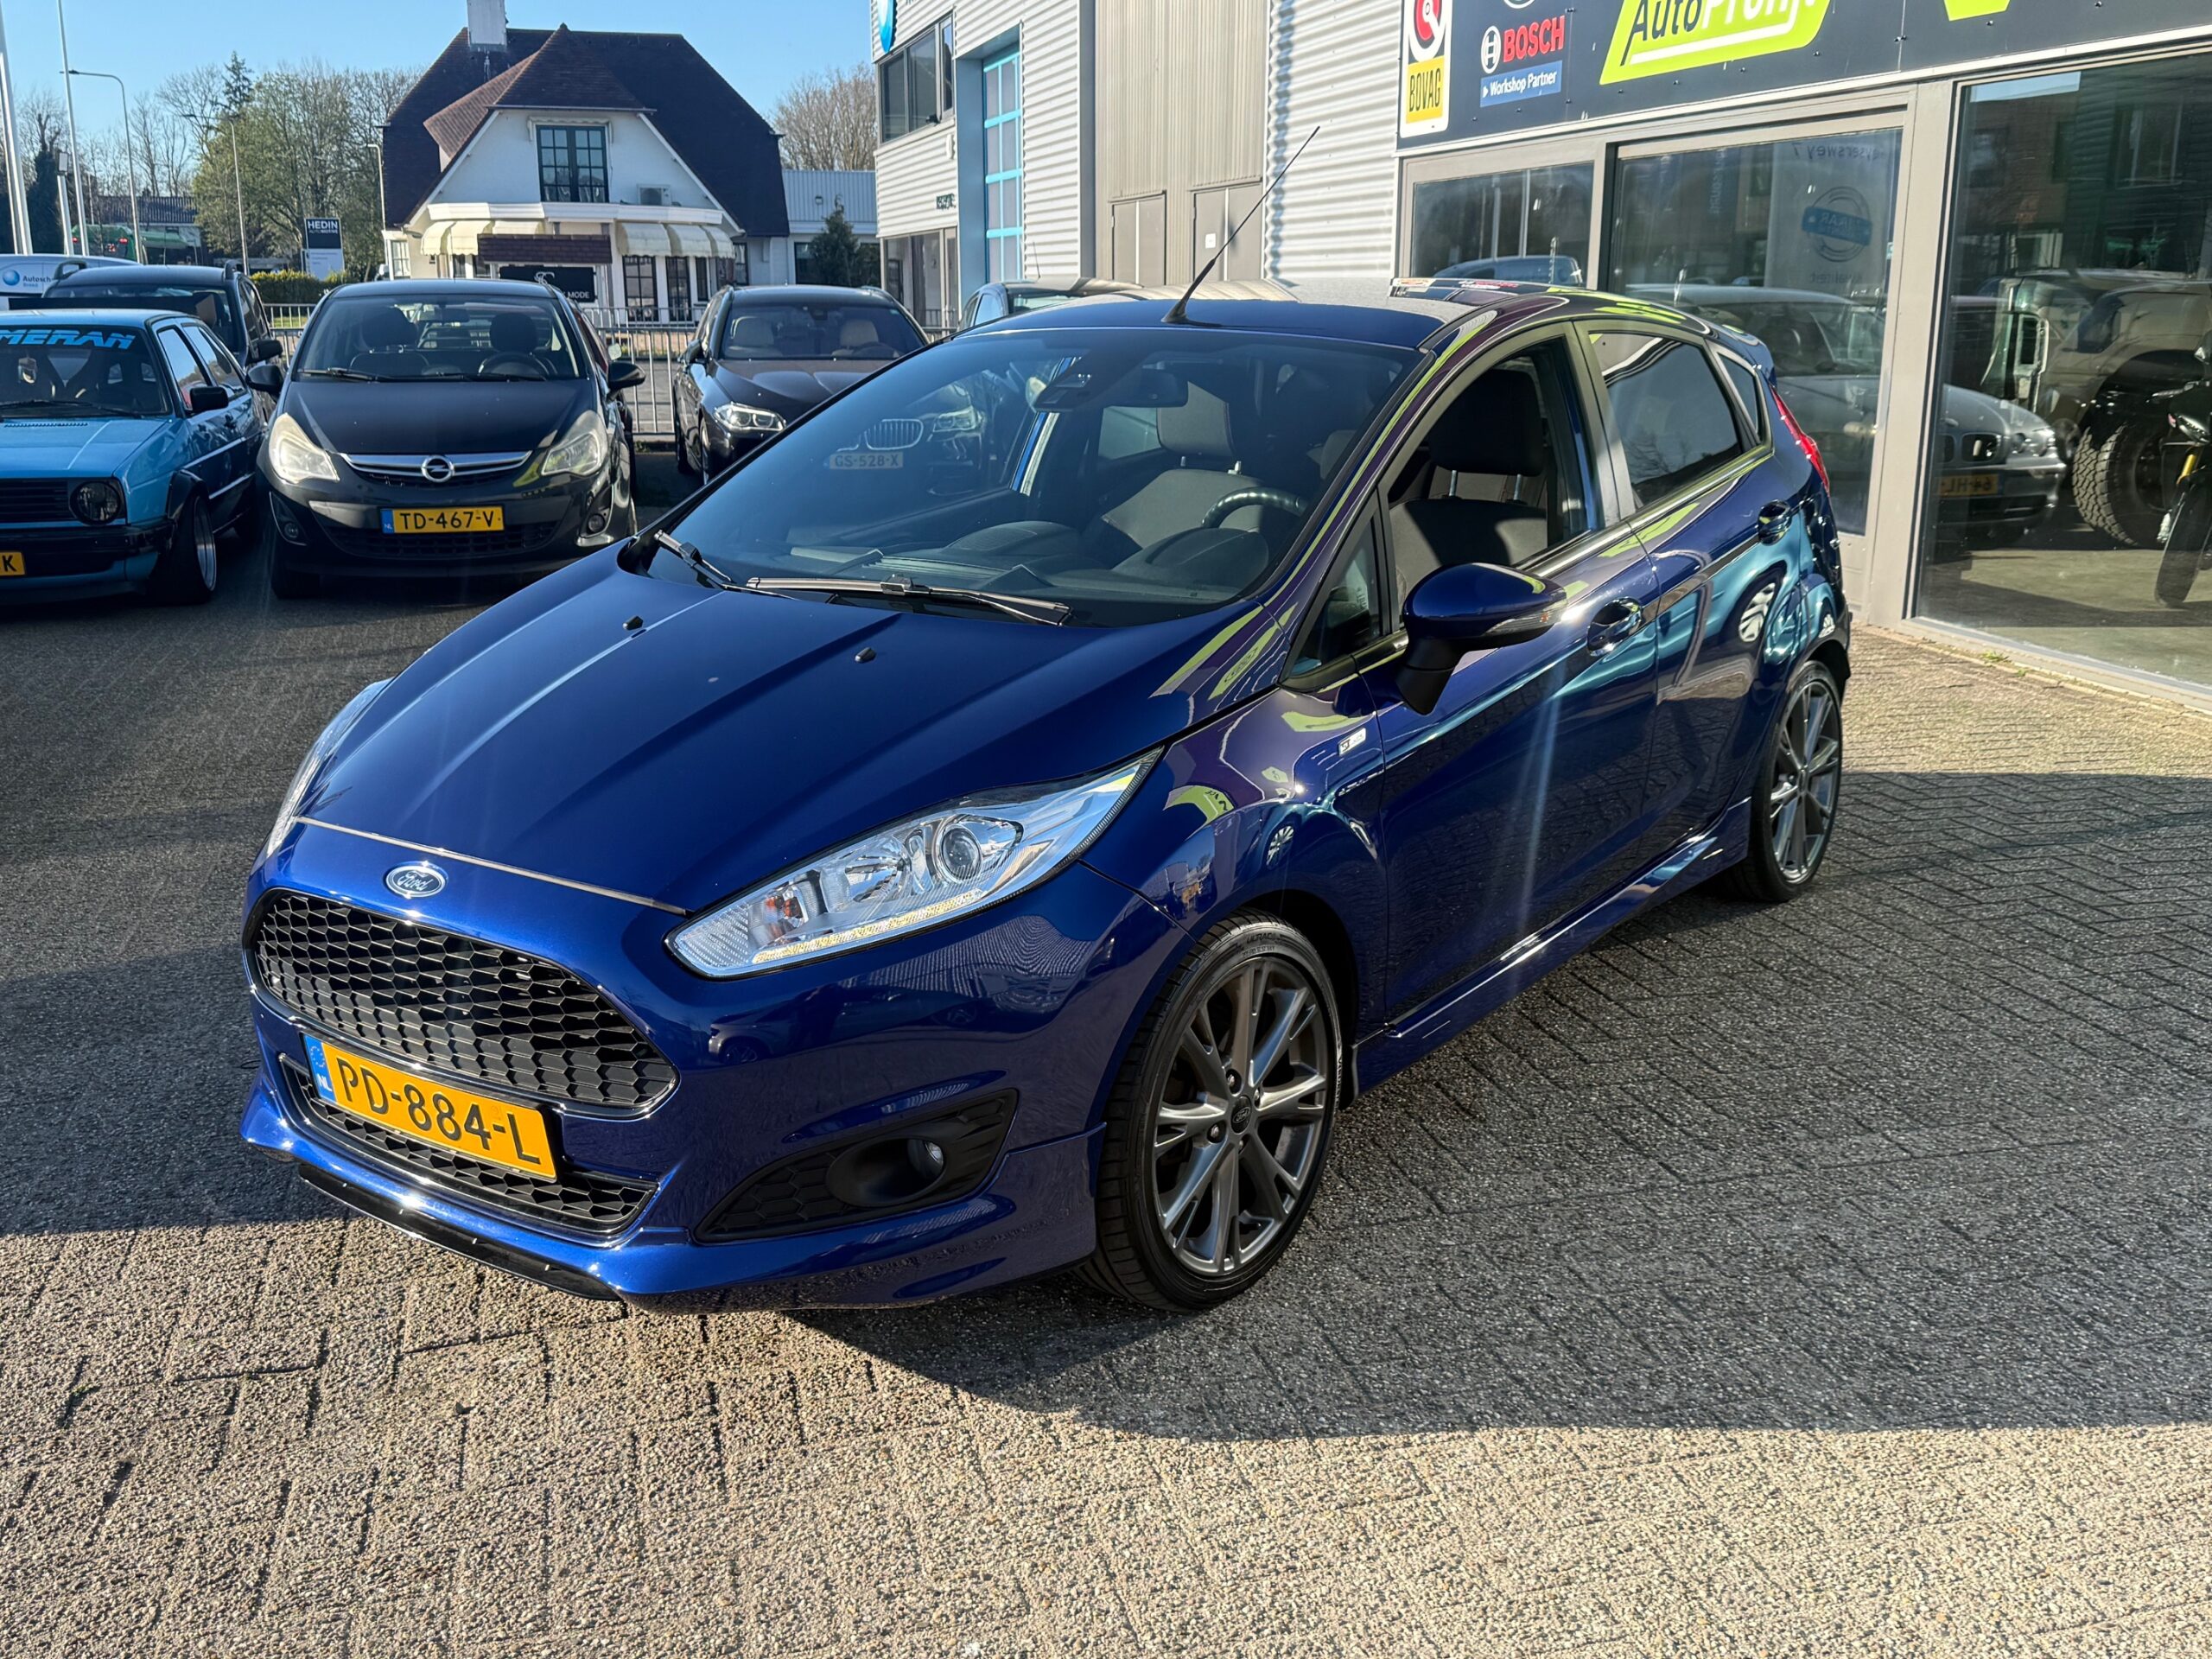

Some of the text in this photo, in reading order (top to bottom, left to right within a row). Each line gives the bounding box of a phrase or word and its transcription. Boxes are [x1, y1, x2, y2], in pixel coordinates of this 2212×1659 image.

[1503, 16, 1565, 62] BOSCH
[1409, 67, 1441, 112] BOVAG
[1490, 70, 1557, 96] Workshop Partner
[307, 220, 338, 229] HEDIN
[835, 454, 899, 467] GS-528-X
[400, 511, 494, 530] TD-467-V
[397, 871, 434, 891] Ford
[316, 1057, 541, 1166] NL PD-884-L
